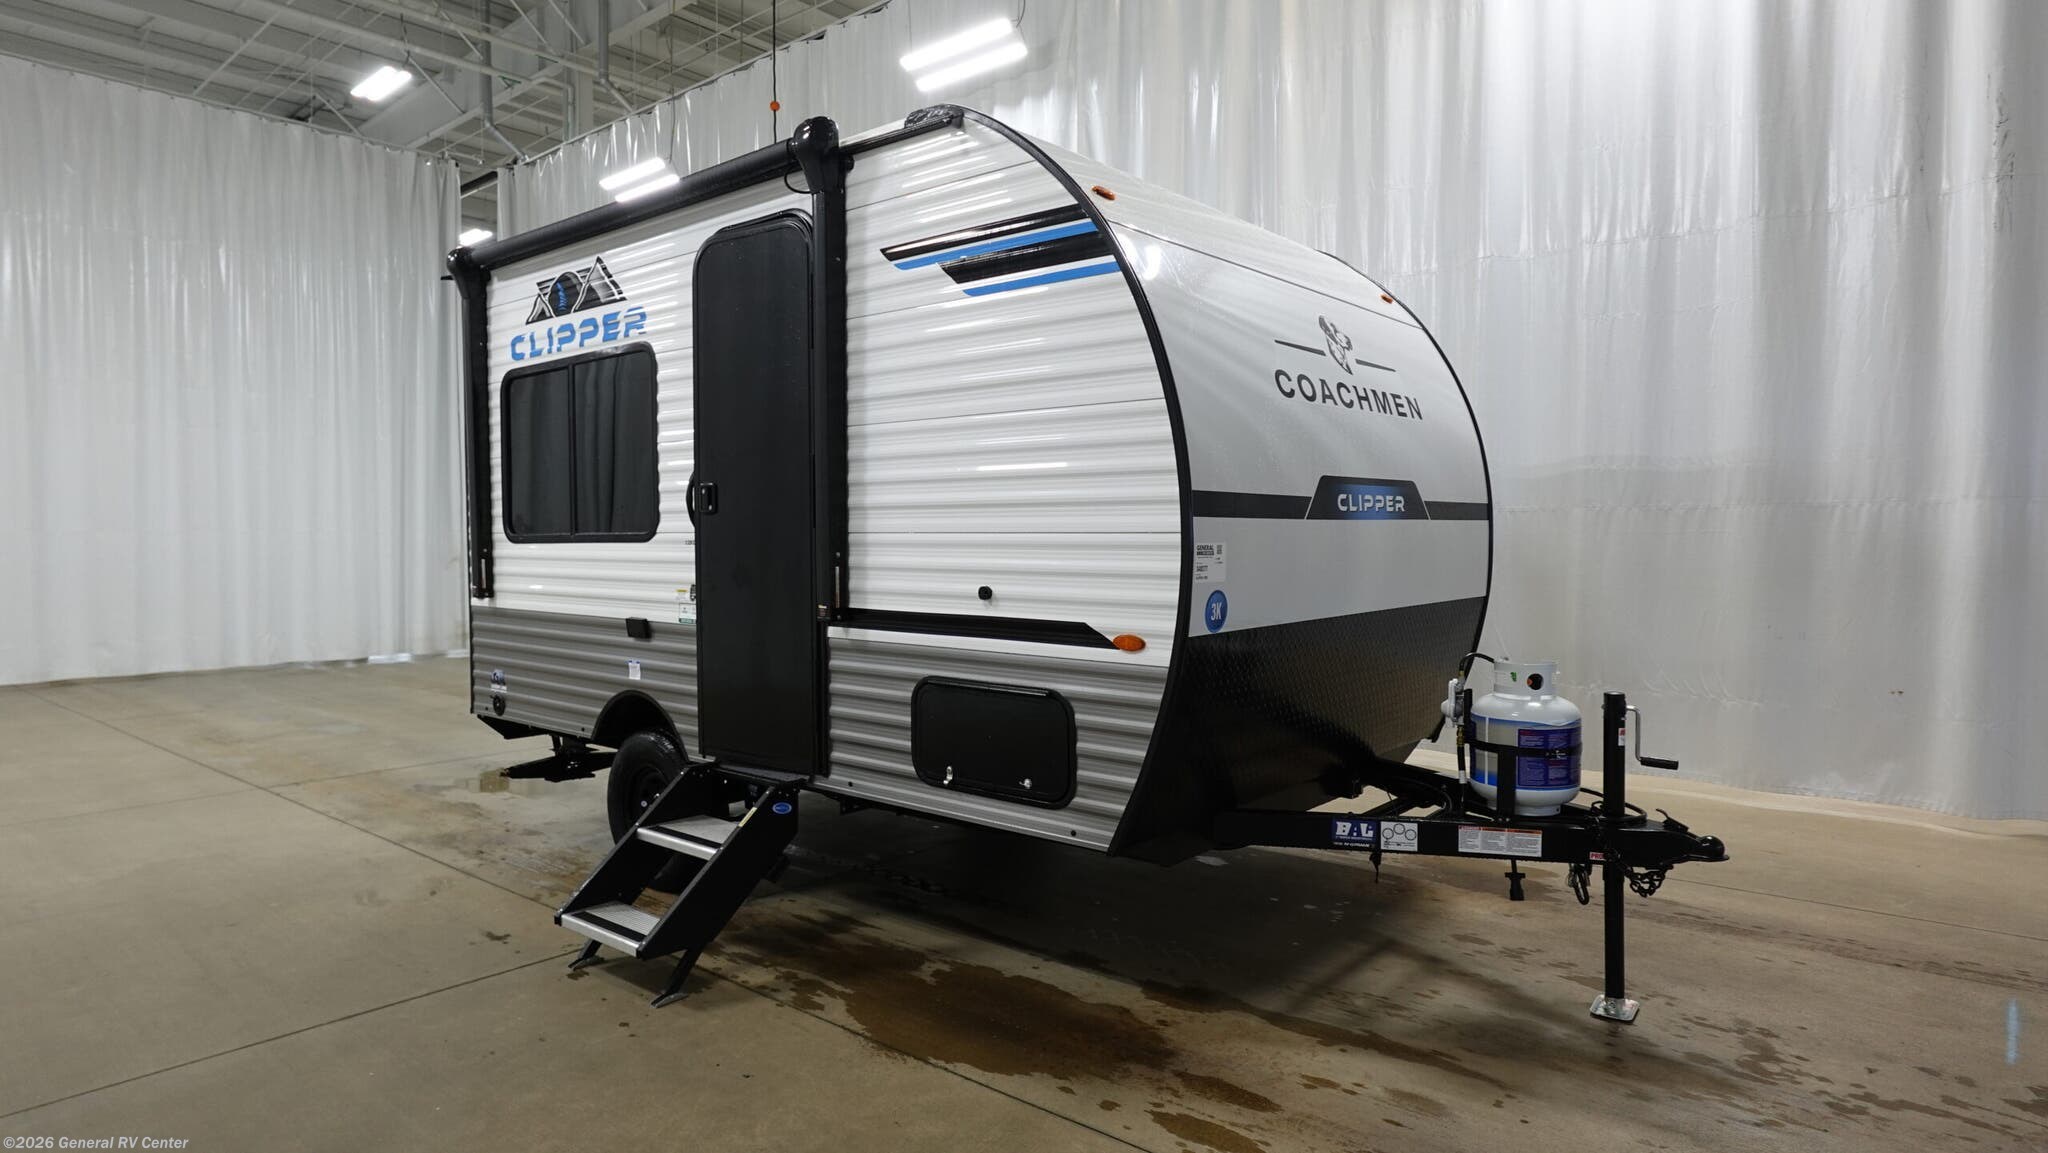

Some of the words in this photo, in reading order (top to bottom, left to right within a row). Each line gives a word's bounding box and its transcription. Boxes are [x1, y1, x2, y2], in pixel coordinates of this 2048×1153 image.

[510, 308, 647, 361] CLIPPER
[1274, 369, 1423, 420] COACHMEN
[1337, 493, 1406, 512] CLIPPER
[1211, 602, 1222, 621] 3K
[1335, 821, 1374, 838] BAL
